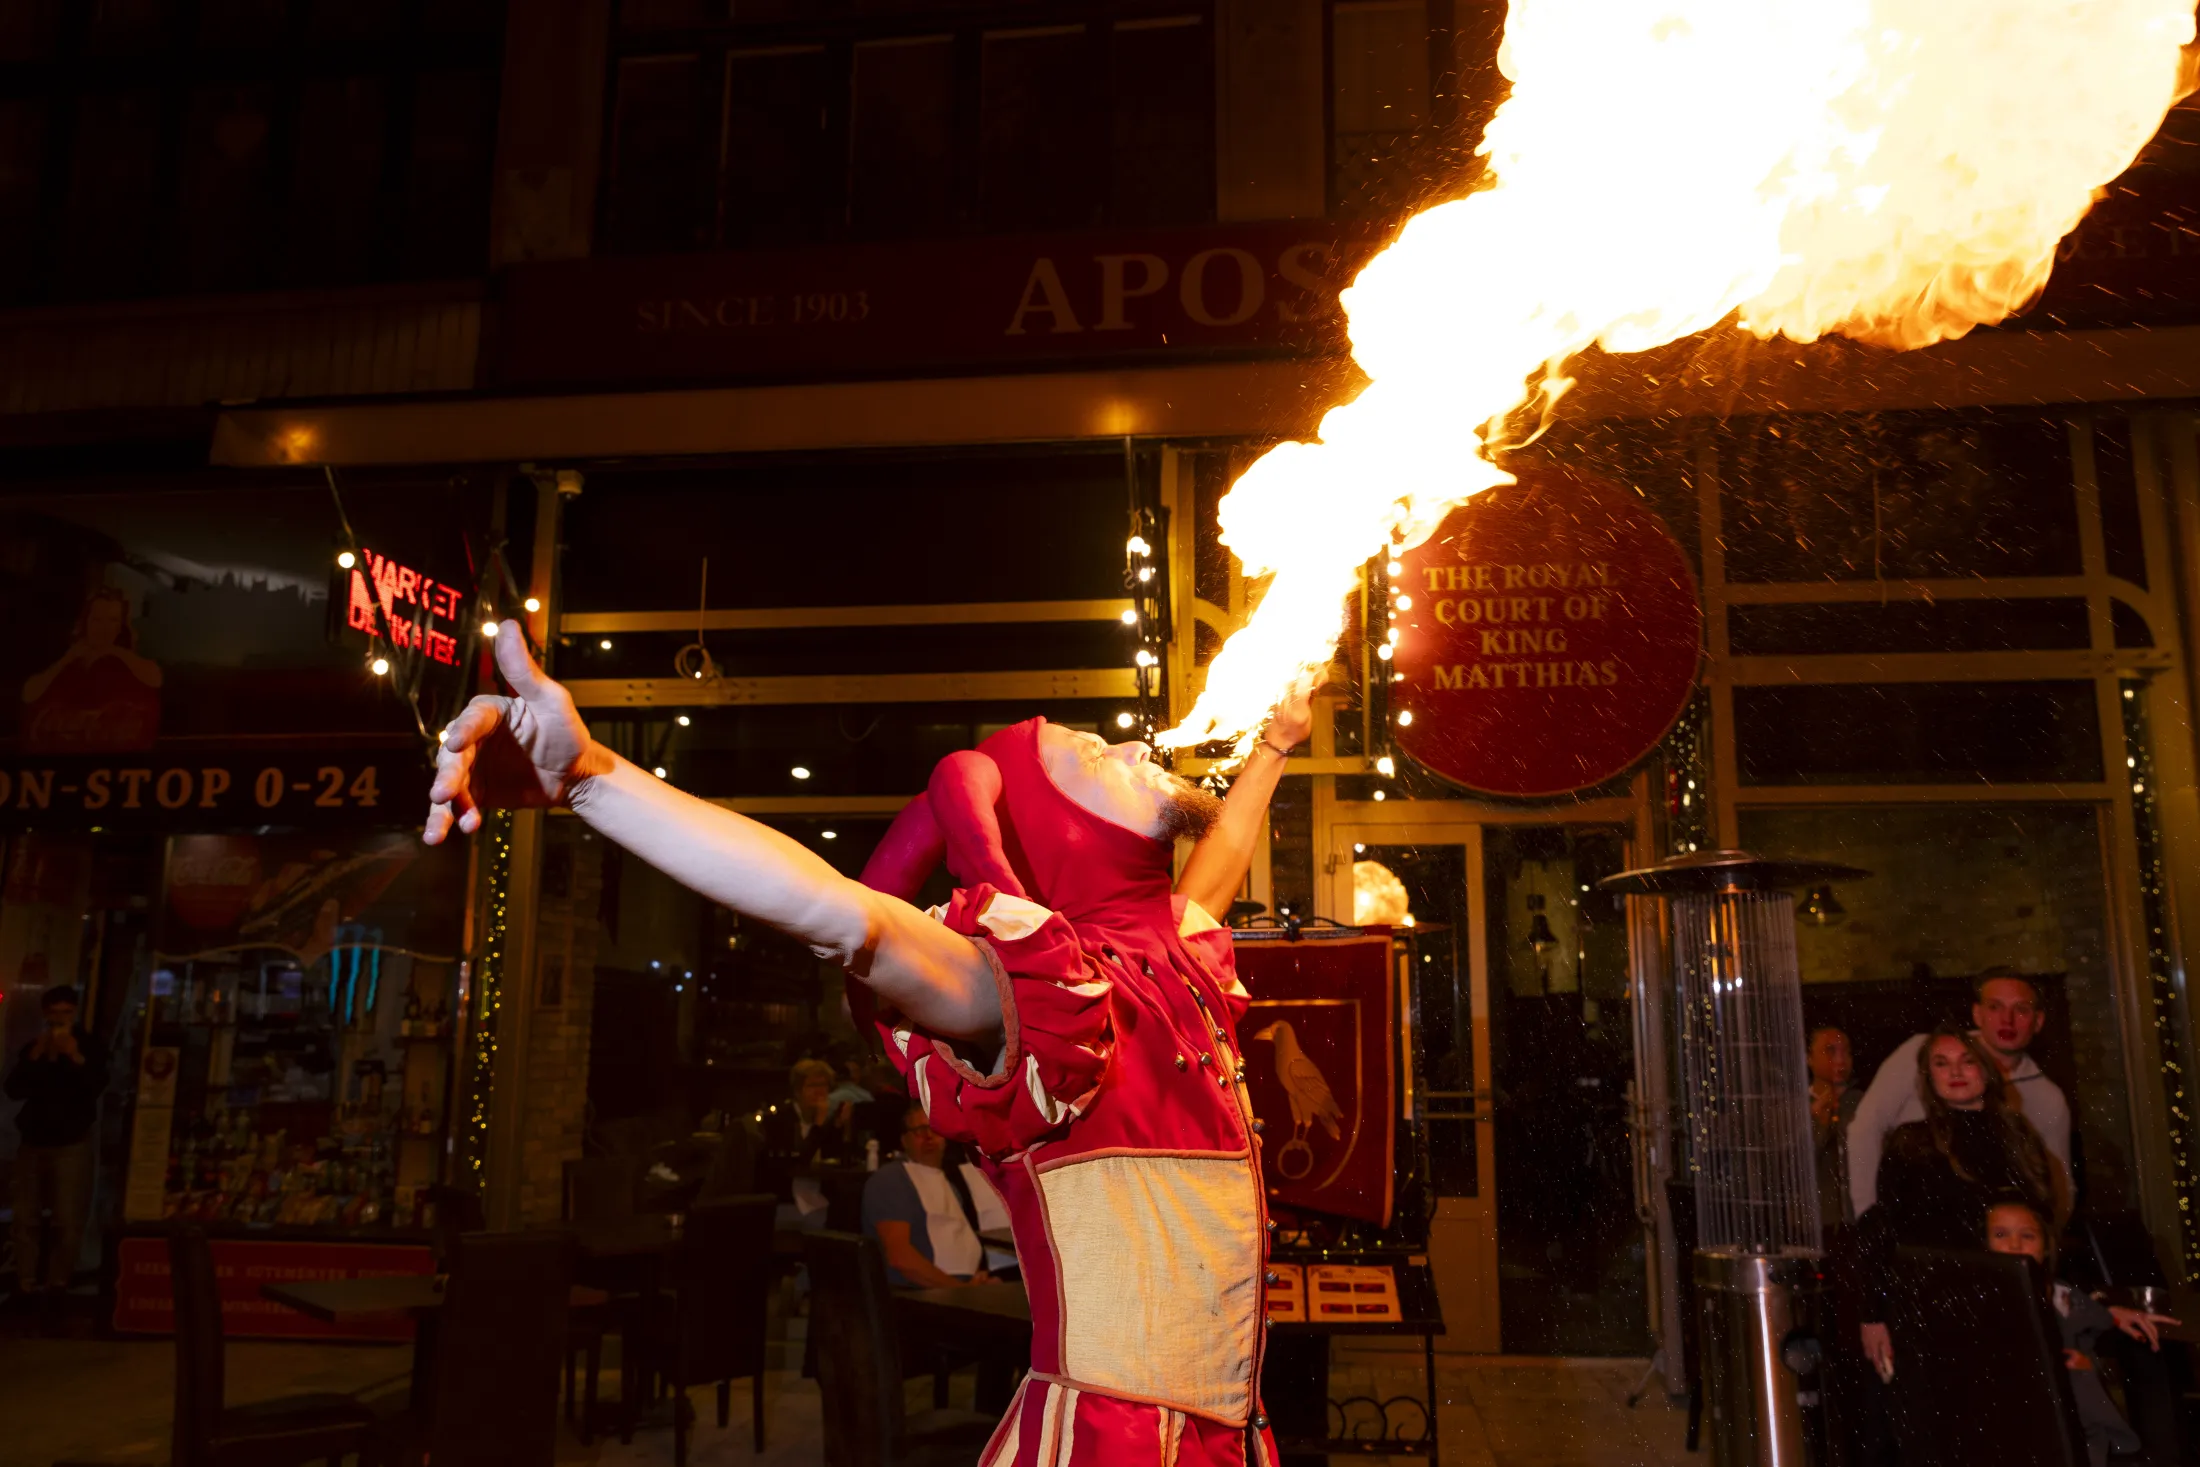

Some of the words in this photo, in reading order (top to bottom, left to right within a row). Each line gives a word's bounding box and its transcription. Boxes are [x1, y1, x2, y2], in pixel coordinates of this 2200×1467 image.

[1003, 243, 1352, 336] APOS
[635, 294, 776, 335] SINCE
[792, 286, 871, 324] 1903
[1422, 565, 1492, 592] THE
[1503, 561, 1619, 590] ROYAL
[1434, 596, 1555, 624] COURT
[1563, 595, 1610, 621] OF
[1479, 628, 1568, 655] KING
[1432, 660, 1619, 691] MATTHIAS
[254, 765, 381, 809] 0-24
